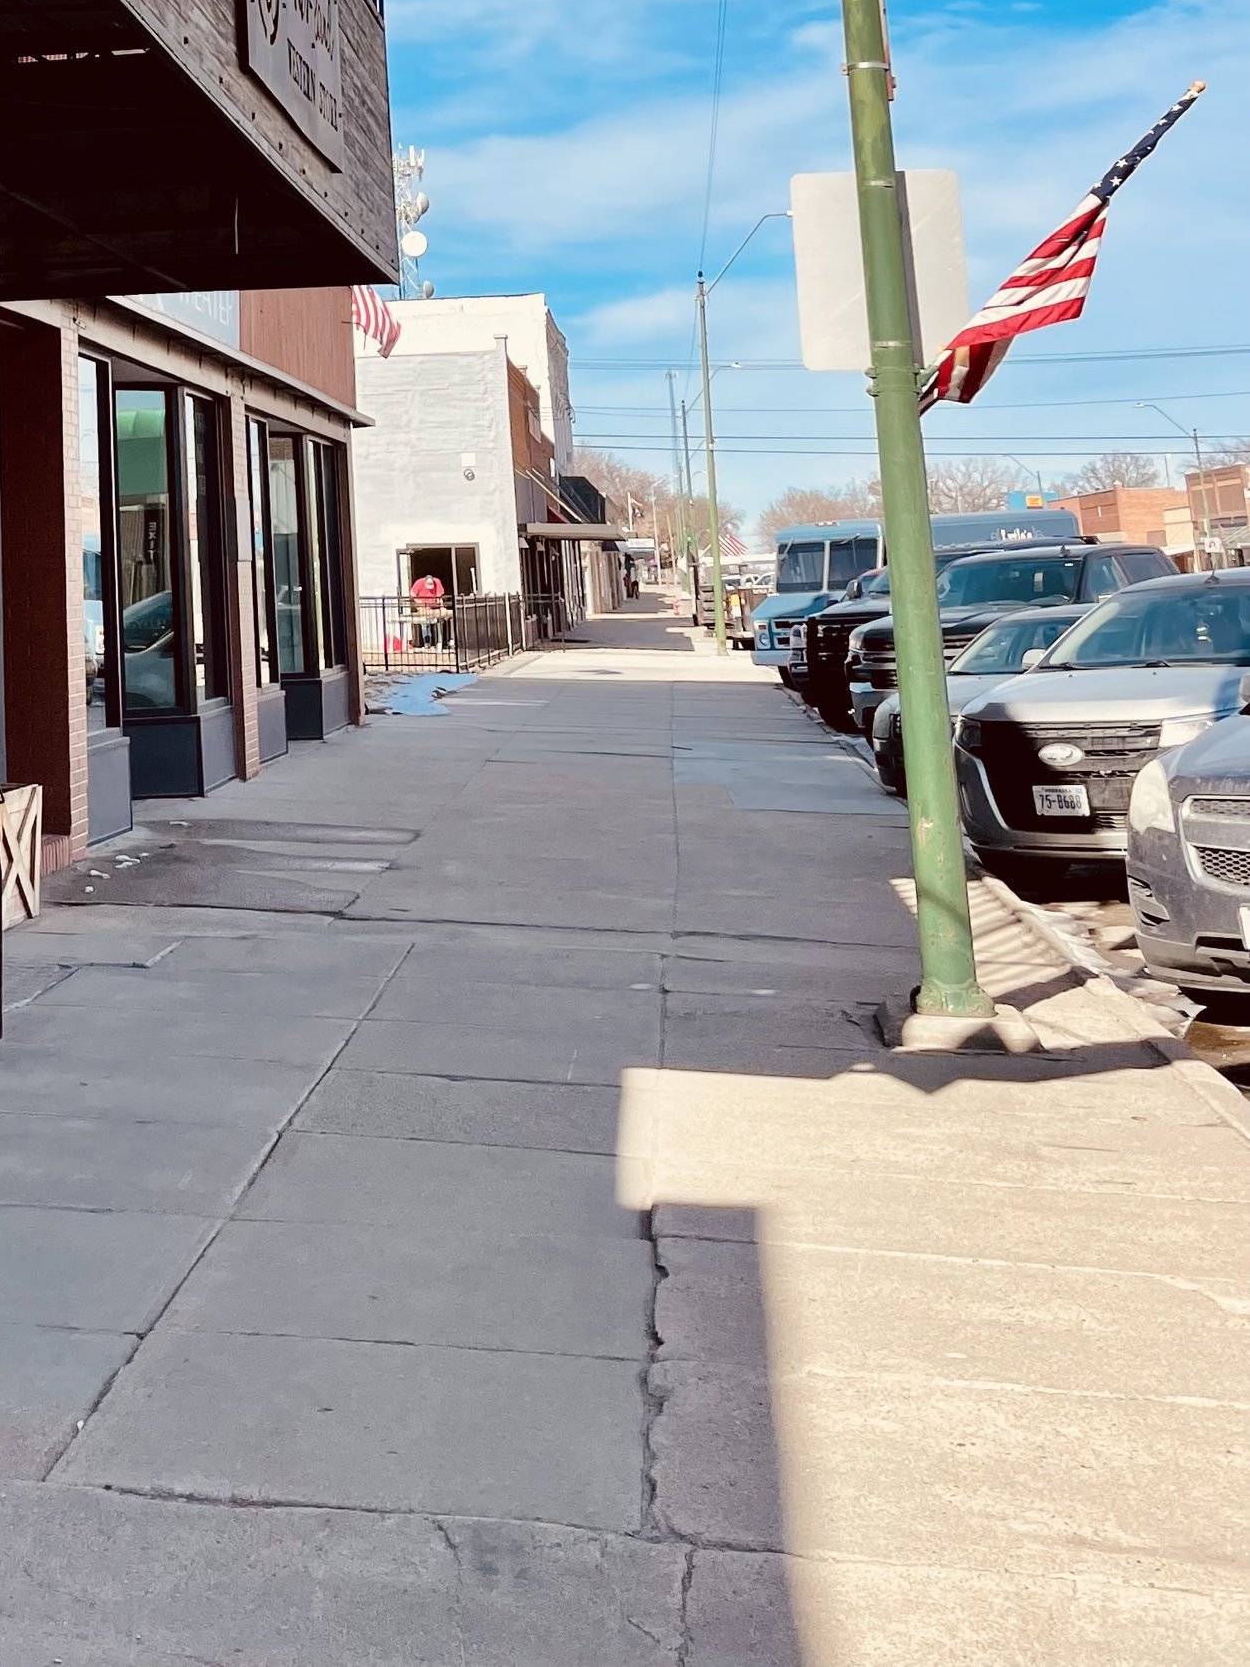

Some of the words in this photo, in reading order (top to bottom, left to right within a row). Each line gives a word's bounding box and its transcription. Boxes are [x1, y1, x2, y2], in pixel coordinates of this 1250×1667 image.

[287, 37, 316, 106] WESTERN
[319, 82, 338, 132] STORE
[180, 293, 232, 326] EATER
